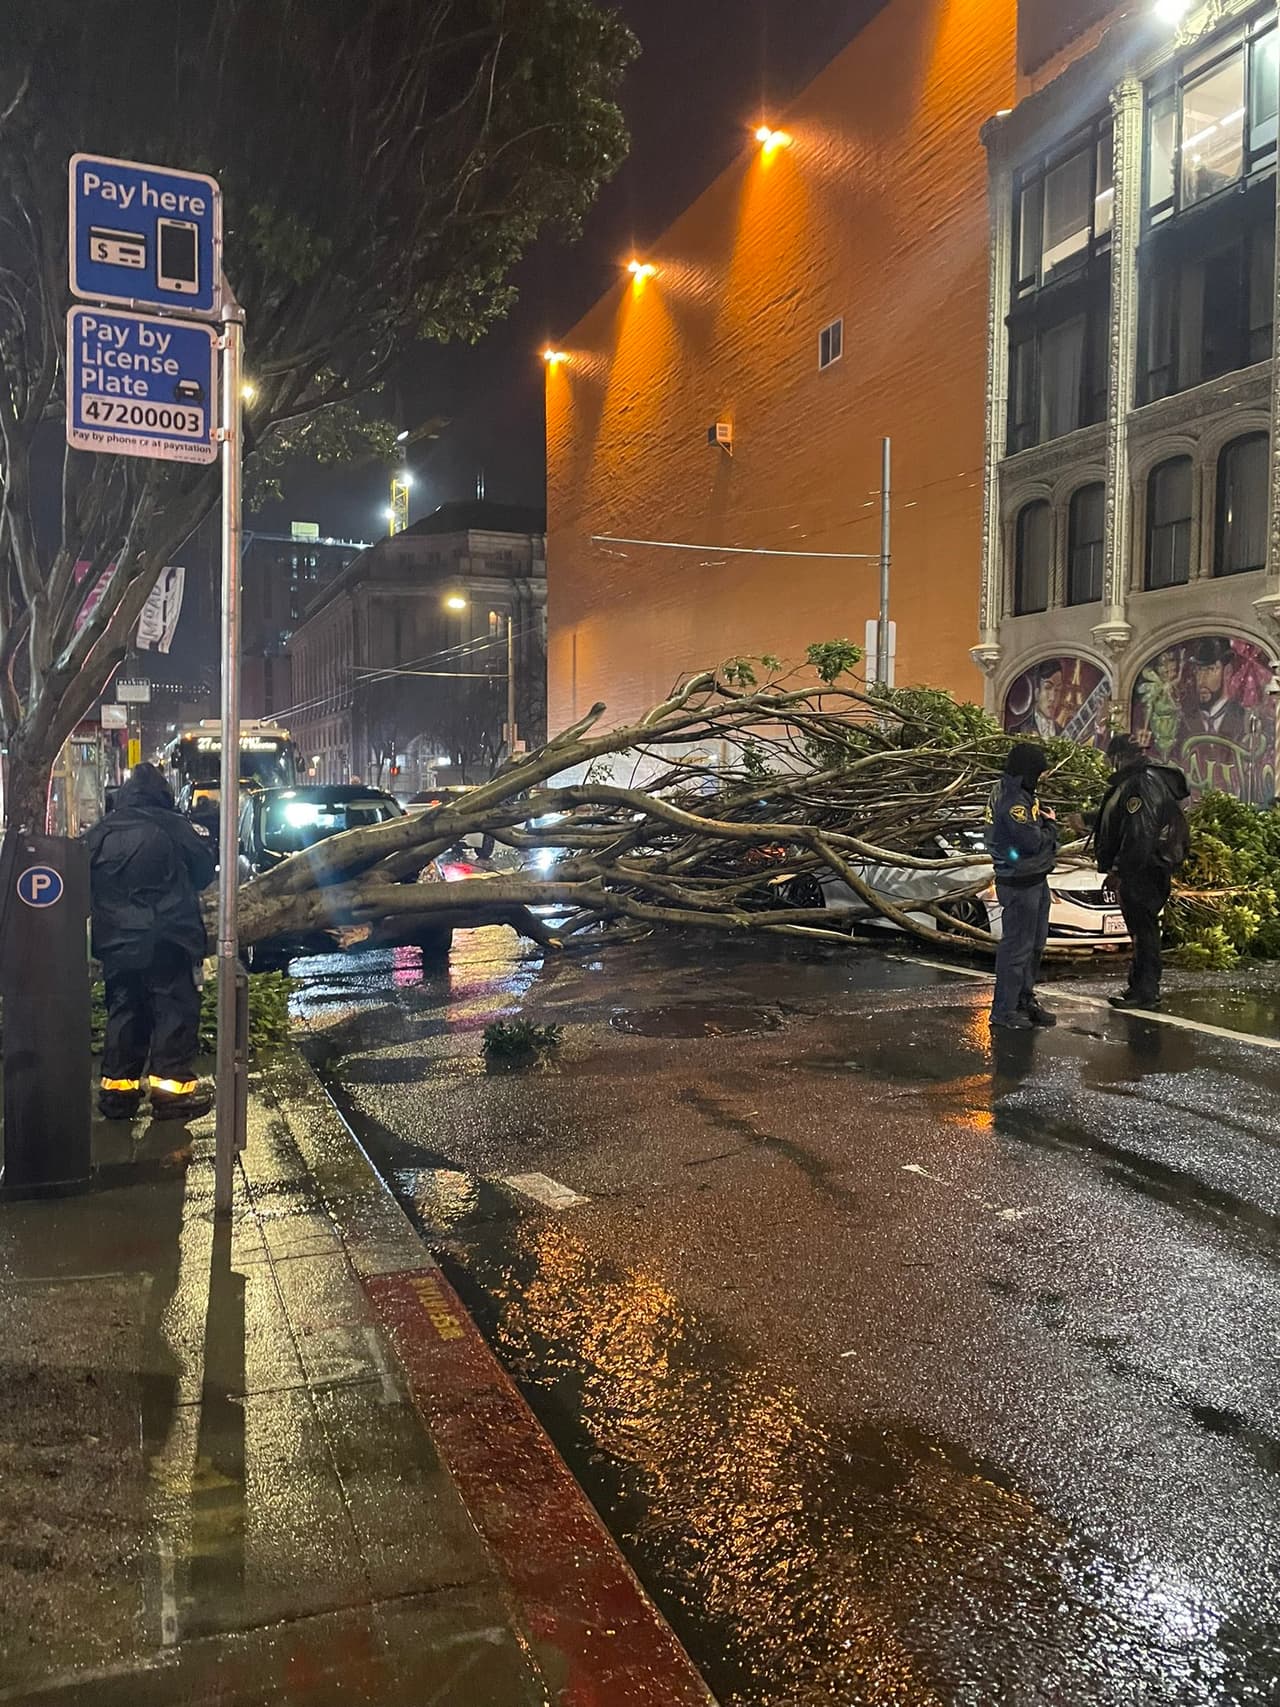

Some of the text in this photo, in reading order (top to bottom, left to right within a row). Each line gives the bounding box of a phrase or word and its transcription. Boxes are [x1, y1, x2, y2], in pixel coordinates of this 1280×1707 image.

[83, 172, 206, 216] Pay here
[81, 316, 172, 355] Pay by
[81, 342, 180, 376] License
[81, 367, 149, 397] Plate
[85, 400, 200, 433] 47200003
[73, 430, 90, 441] Pay
[92, 431, 105, 443] by
[107, 433, 137, 445] phone
[152, 440, 161, 448] at
[163, 441, 212, 454] paystation
[32, 874, 52, 900] P
